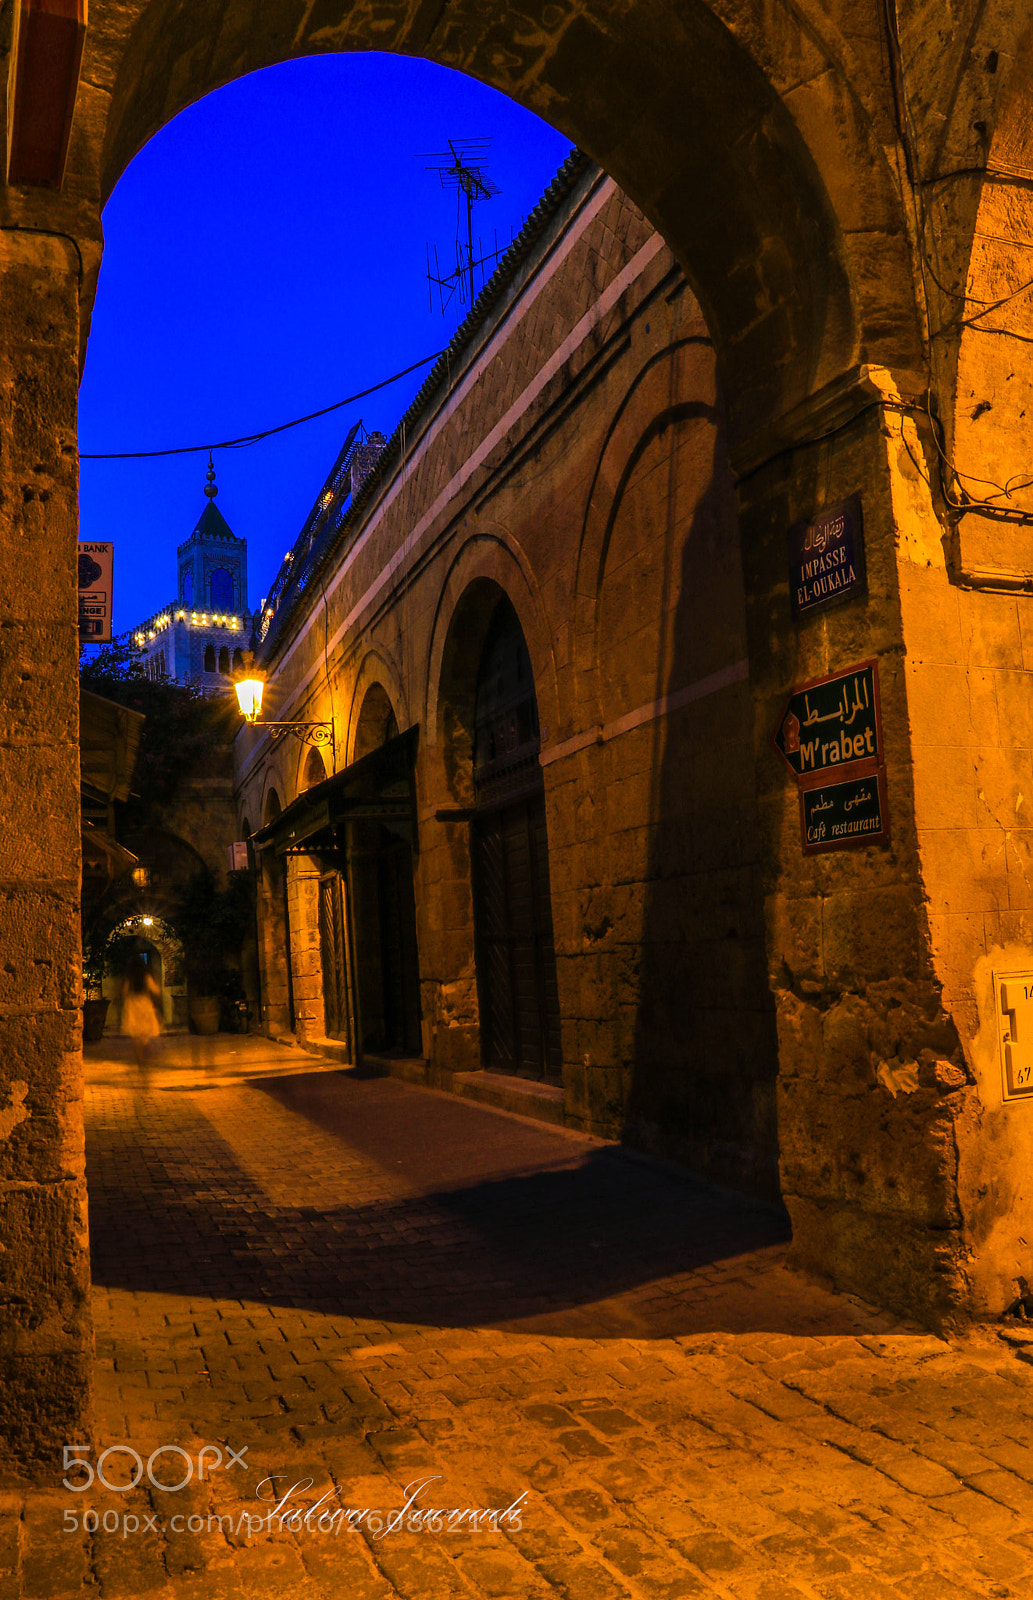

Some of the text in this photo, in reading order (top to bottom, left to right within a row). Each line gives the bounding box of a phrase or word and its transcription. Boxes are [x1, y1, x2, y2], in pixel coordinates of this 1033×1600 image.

[83, 544, 109, 553] BANK
[801, 546, 847, 582] IMPASSE
[797, 564, 857, 605] EL-OUKALA
[802, 676, 870, 727] المرابط
[800, 726, 875, 771] M'rabet
[810, 793, 834, 823] مطعم
[831, 815, 880, 836] restaurant
[1016, 1066, 1031, 1084] 67
